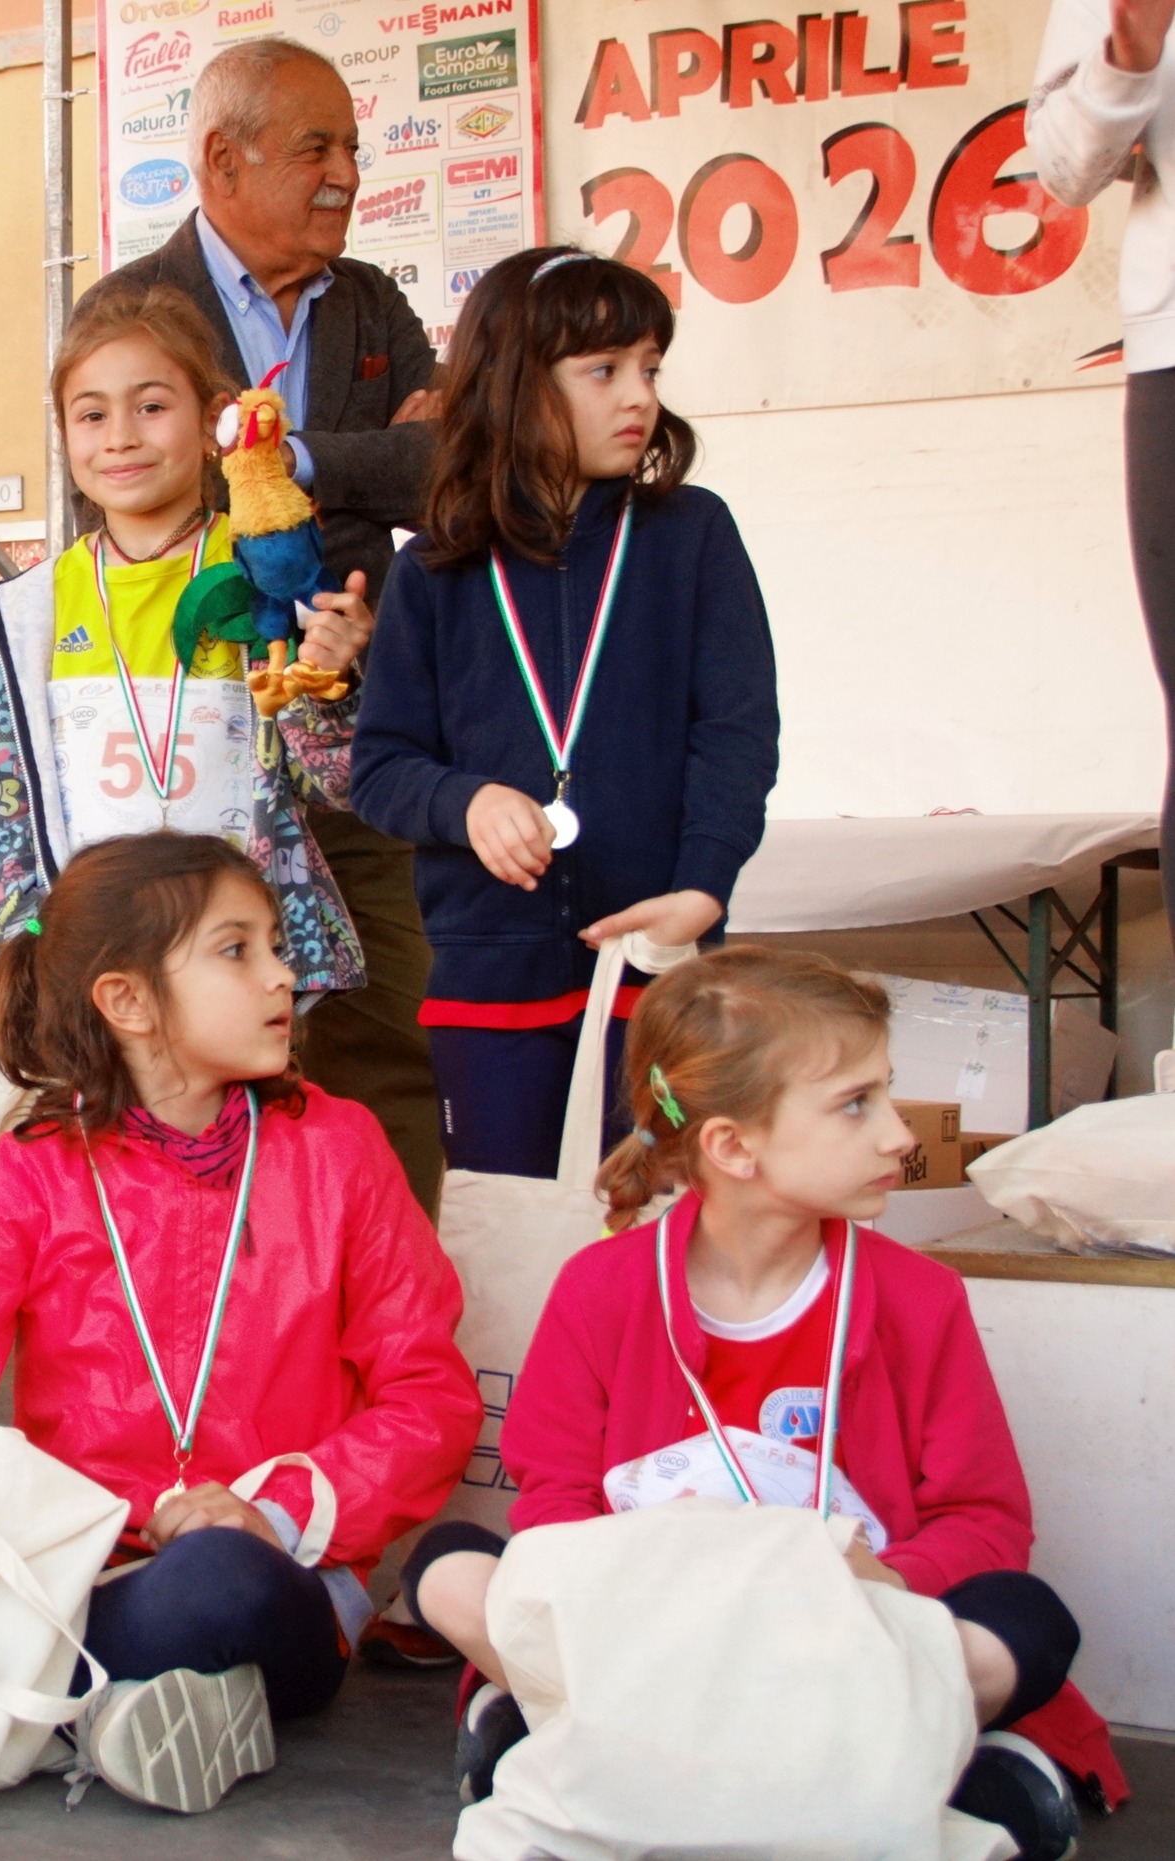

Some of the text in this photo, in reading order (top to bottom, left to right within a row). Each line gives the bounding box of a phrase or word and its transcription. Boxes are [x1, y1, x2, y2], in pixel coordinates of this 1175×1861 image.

[218, 1, 274, 28] Randi
[124, 30, 192, 77] Frullà
[340, 45, 401, 67] GROUP
[435, 45, 475, 64] Euro
[574, 0, 971, 129] APRILE
[423, 53, 509, 79] Company
[424, 76, 509, 97] Food for Change
[121, 112, 176, 135] natura
[387, 136, 437, 150] ravenna
[581, 98, 1090, 308] 2026
[55, 639, 94, 654] adidas
[72, 709, 95, 718] LUCCI
[99, 731, 196, 799] 55
[657, 1454, 687, 1469] LUCCI
